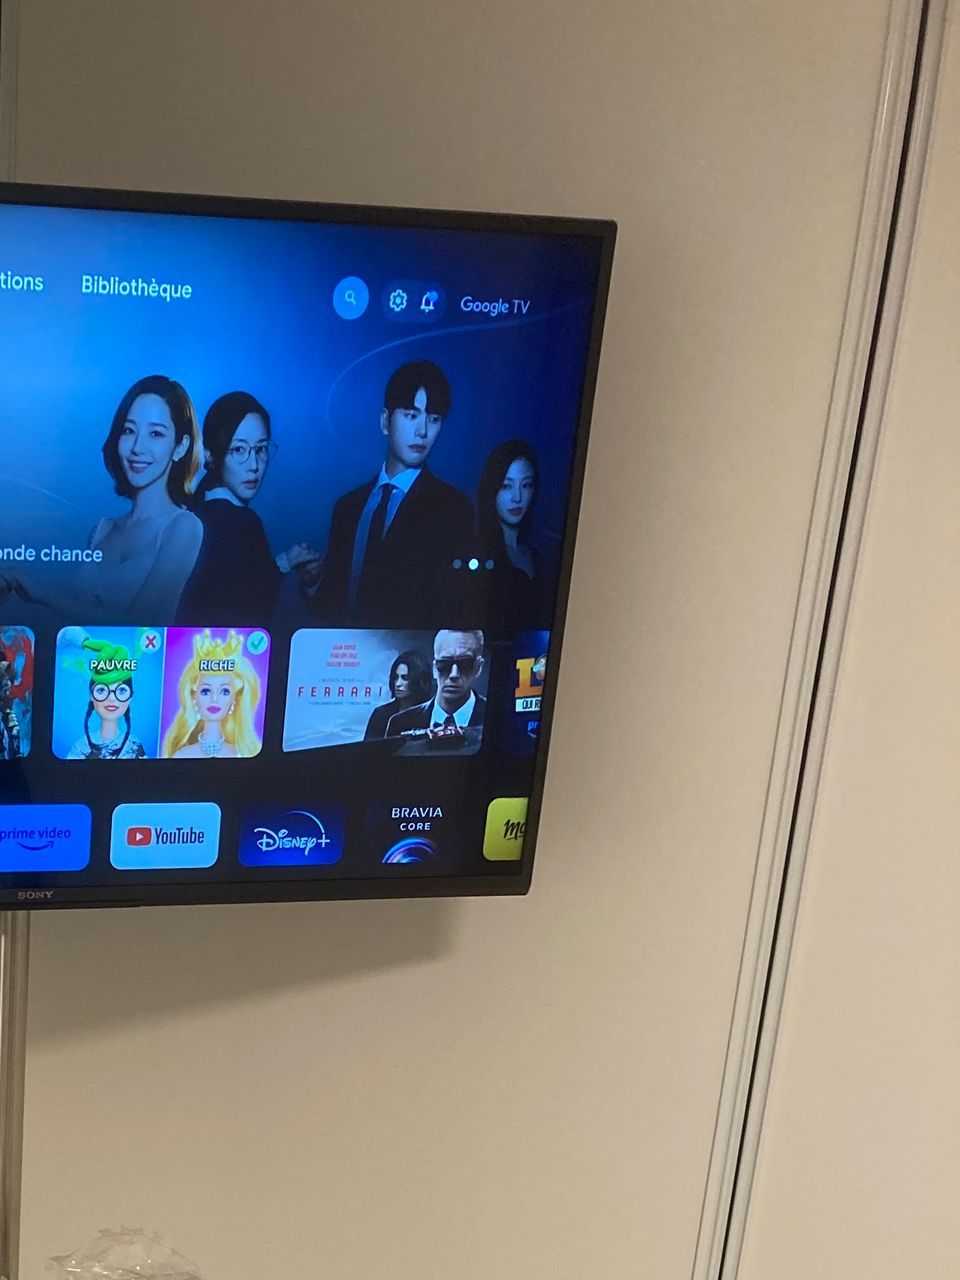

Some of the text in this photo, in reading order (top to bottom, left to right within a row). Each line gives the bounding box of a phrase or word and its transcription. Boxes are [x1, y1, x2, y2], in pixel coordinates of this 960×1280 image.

[81, 275, 192, 302] Bibliothèque
[460, 296, 531, 317] Google TV
[40, 545, 103, 563] chance
[90, 659, 138, 672] PAUVRE
[199, 659, 235, 672] RICHE
[298, 686, 382, 698] FERRARI
[391, 806, 443, 819] BRAVIA
[400, 822, 431, 831] CORE
[0, 826, 71, 843] prime video
[154, 826, 205, 845] YouTube
[17, 890, 54, 900] SONY
